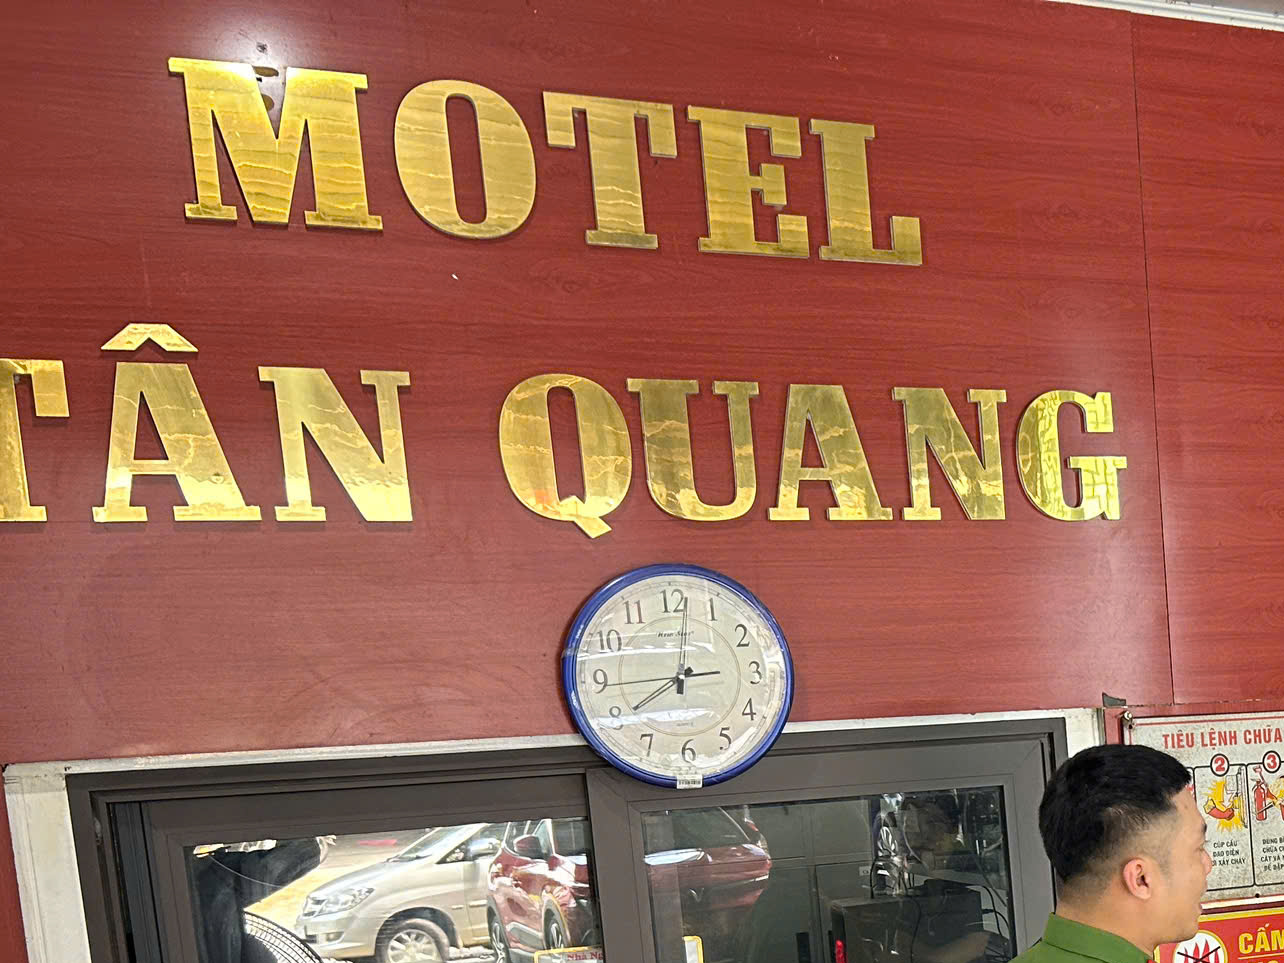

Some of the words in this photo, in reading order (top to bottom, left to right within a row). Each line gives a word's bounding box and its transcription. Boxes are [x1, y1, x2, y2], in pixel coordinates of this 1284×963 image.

[168, 57, 924, 266] MOTEL
[0, 323, 413, 523] TÂN
[498, 372, 1128, 539] QUANG
[622, 600, 646, 624] 11
[660, 588, 684, 614] 12
[708, 598, 718, 621] 1
[597, 629, 623, 652] 10
[734, 623, 750, 648] 2
[592, 668, 609, 694] 9
[748, 661, 762, 685] 3
[741, 697, 757, 721] 4
[639, 733, 654, 757] 7
[718, 727, 732, 750] 5
[1162, 729, 1195, 749] TIÊU
[1200, 727, 1238, 750] LỆNH
[1243, 725, 1283, 745] CHỮA
[680, 739, 697, 763] 6
[1266, 754, 1278, 769] 3
[1214, 757, 1226, 772] 2
